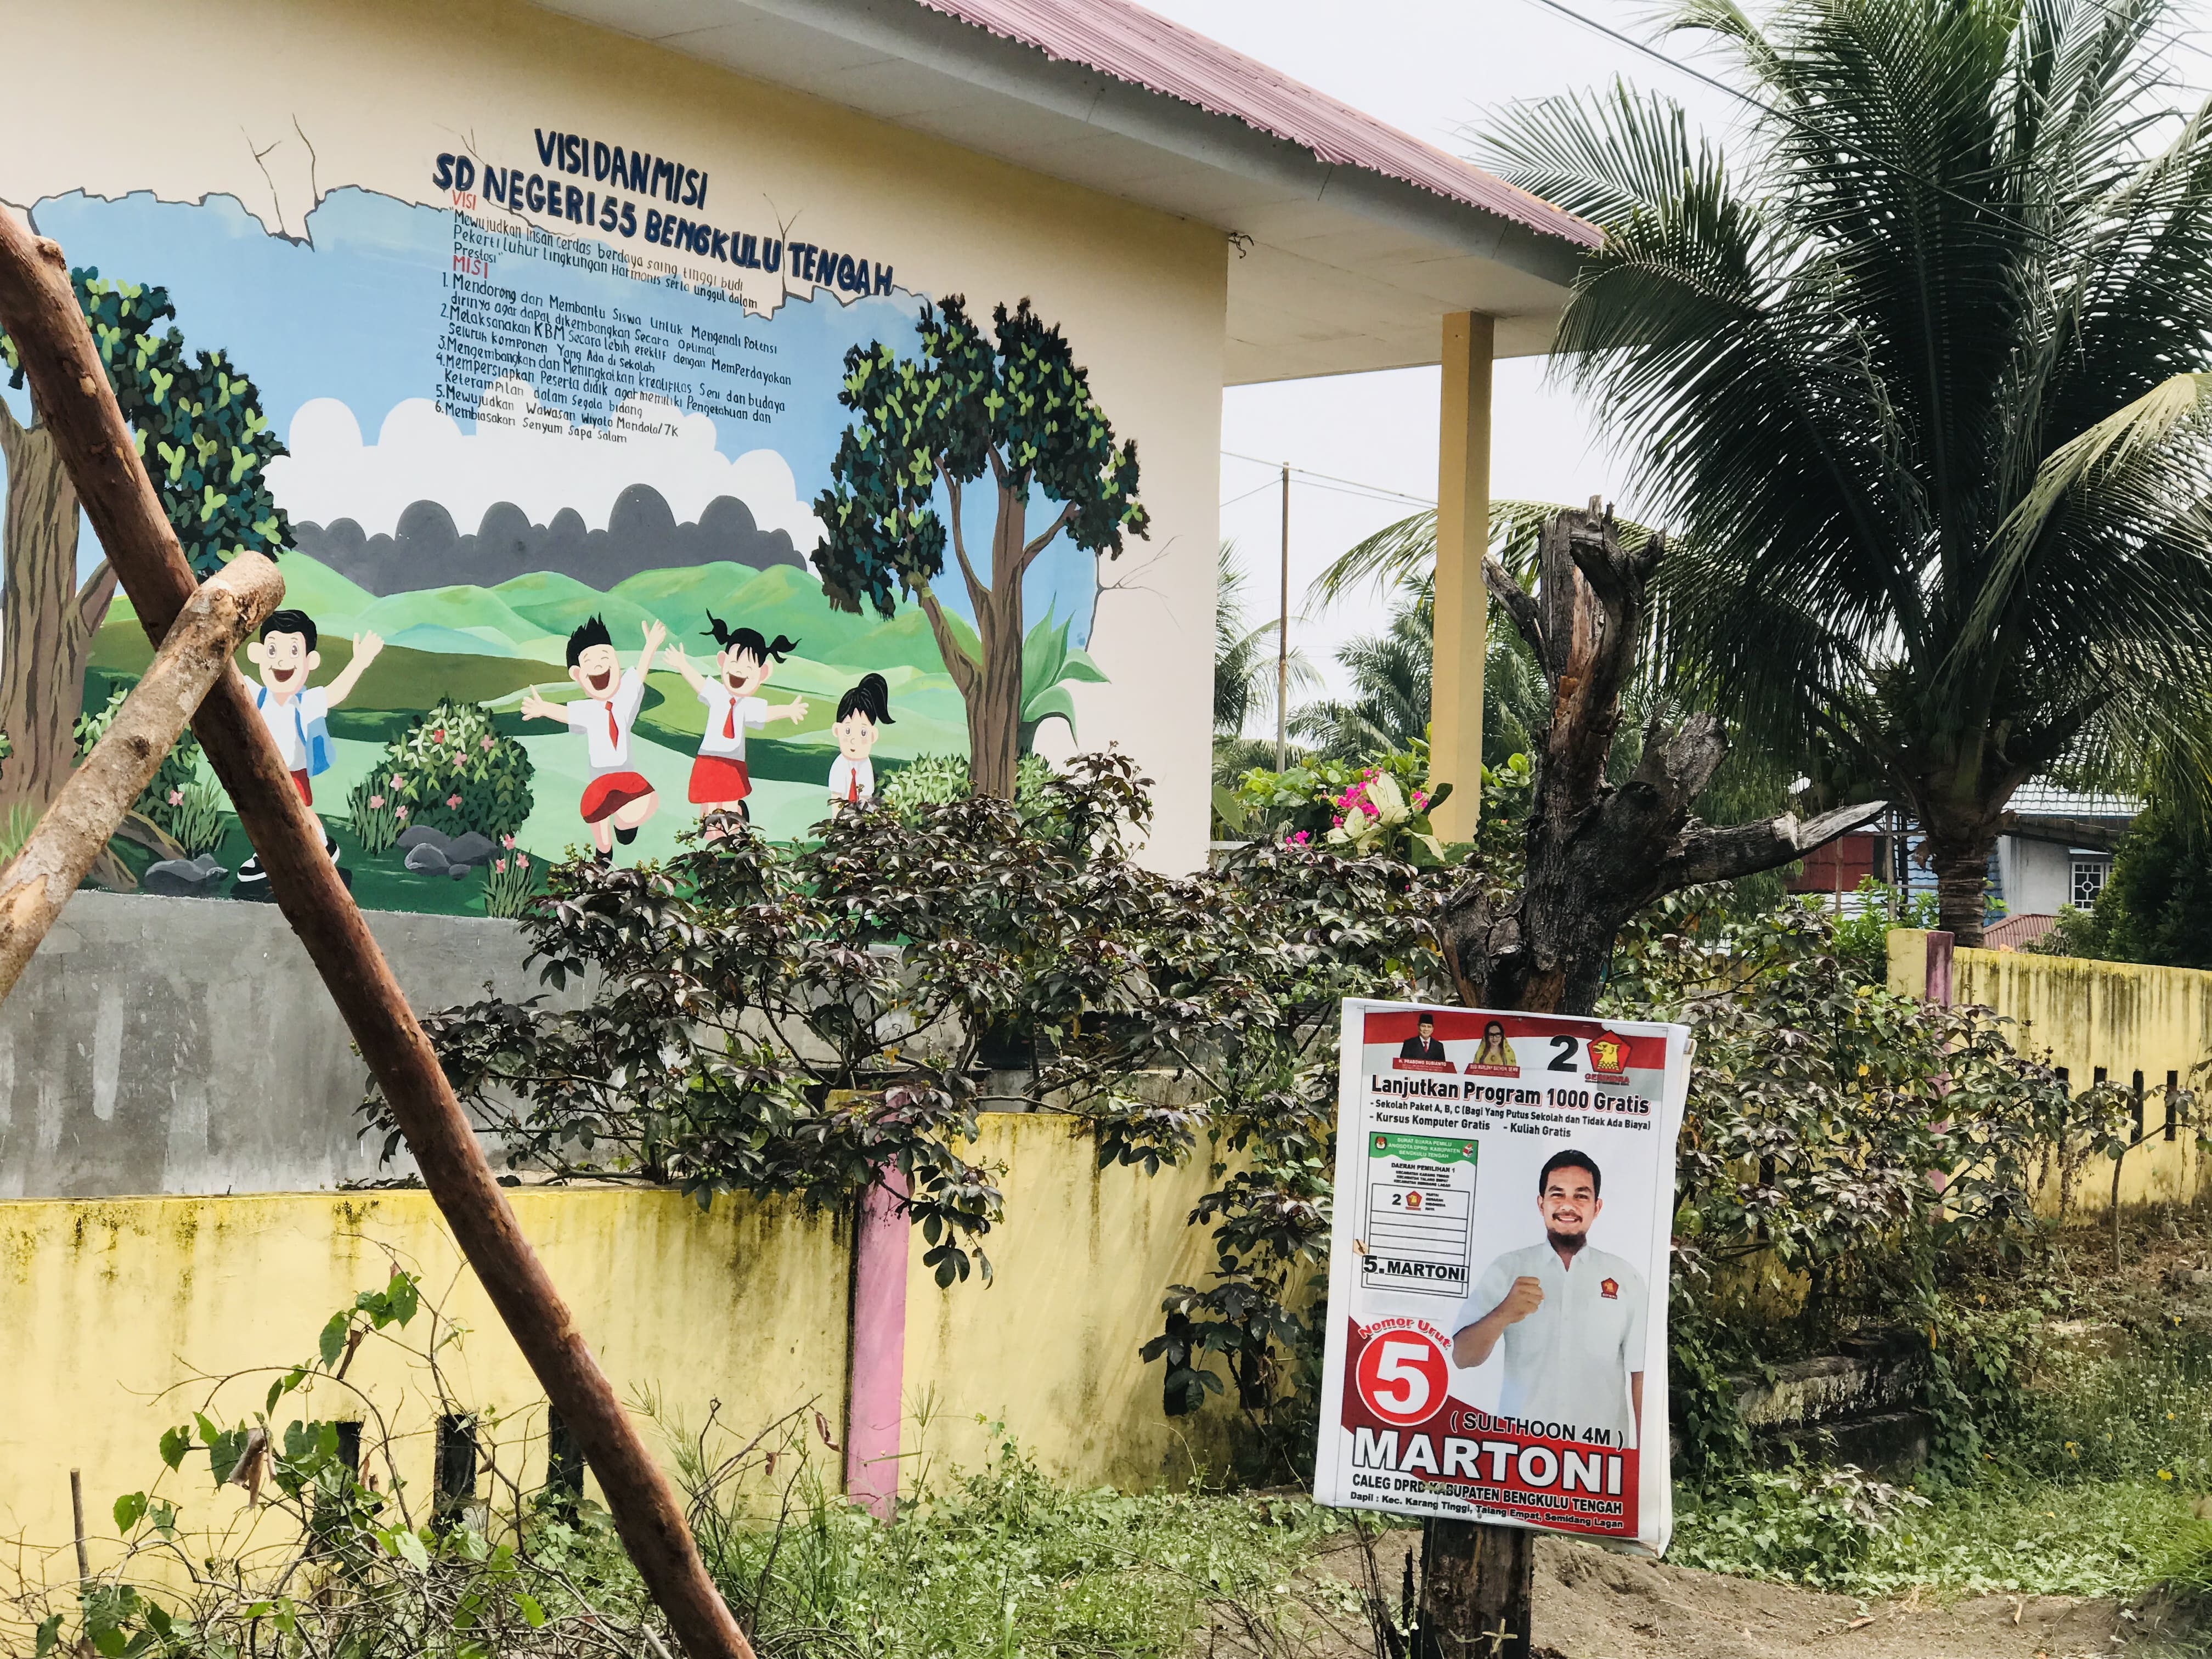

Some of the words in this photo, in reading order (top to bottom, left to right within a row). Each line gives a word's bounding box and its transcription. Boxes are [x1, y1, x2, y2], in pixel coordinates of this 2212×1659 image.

[452, 190, 477, 211] VISI
[433, 153, 475, 193] SD
[483, 164, 595, 225] NEGERI
[599, 196, 637, 238] 55
[644, 208, 782, 273] BENGKULU
[787, 241, 893, 296] TENGAH
[453, 224, 499, 249] Pekerti
[503, 237, 539, 257] luhur
[612, 263, 661, 285] Harmonis
[694, 285, 725, 303] unggul
[453, 255, 488, 279] MISI
[597, 243, 643, 269] berdaya
[683, 267, 716, 286] tinggi
[721, 276, 742, 291] budi
[442, 272, 448, 287] 1.
[453, 273, 516, 304] Mendorong
[521, 291, 543, 307] dan
[550, 295, 605, 319] Membantu
[613, 308, 641, 325] Siswa
[691, 325, 741, 347] Mengenali
[451, 291, 490, 312] dirinya
[494, 303, 517, 317] agar
[556, 314, 630, 338] dikembangkan
[635, 329, 669, 347] Secara
[534, 321, 565, 341] KBM
[605, 337, 630, 354] lebih
[673, 352, 705, 369] dengan
[557, 344, 581, 363] Yang
[586, 349, 603, 363] Ada
[608, 354, 616, 365] di
[534, 386, 567, 404] dalam
[609, 400, 642, 419] bidang
[538, 356, 560, 370] dan
[563, 357, 634, 385] Meningkatkan
[699, 382, 720, 399] Seni
[726, 390, 745, 405] dan
[748, 392, 785, 414] budaya
[540, 370, 579, 391] Peserta
[583, 379, 608, 396] didik
[614, 388, 637, 400] agar
[640, 391, 682, 408] memiliki
[687, 395, 748, 420] Pengetahuan
[753, 409, 771, 424] dan
[445, 402, 516, 426] Membiasakan
[523, 417, 562, 435] Senyum
[568, 425, 592, 440] Sapa
[597, 431, 627, 443] Salam
[526, 402, 575, 421] Wawasan
[1547, 1035, 1579, 1073] 2
[1372, 1074, 1459, 1099] Lanjutkan
[1464, 1081, 1541, 1105] Program
[1547, 1088, 1589, 1109] 1000
[1594, 1092, 1650, 1114] Gratis
[1375, 1099, 1408, 1110] Sekolah
[1410, 1102, 1433, 1113] Paket
[1434, 1104, 1443, 1114] A,
[1444, 1104, 1453, 1115] B,
[1454, 1105, 1460, 1114] C
[1462, 1105, 1483, 1118] (Bagi
[1485, 1108, 1504, 1119] Yang
[1506, 1109, 1529, 1120] Putus
[1531, 1111, 1563, 1122] Sekolah
[1565, 1114, 1580, 1124] dan
[1582, 1116, 1605, 1126] Tidak
[1606, 1118, 1622, 1127] Ada
[1624, 1120, 1650, 1131] Biaya)
[1376, 1112, 1410, 1124] Kursus
[1412, 1115, 1459, 1128] Komputer
[1462, 1119, 1490, 1130] Gratis
[1510, 1123, 1539, 1135] Kuliah
[1542, 1126, 1571, 1137] Gratis
[1392, 1194, 1402, 1206] 2
[1387, 1260, 1465, 1280] MARTONI
[1357, 1318, 1415, 1339] Nomor
[1418, 1319, 1452, 1350] Urut
[1373, 1341, 1430, 1414] 5
[1464, 1412, 1576, 1441] SULTHOON
[1582, 1427, 1611, 1445] 4M
[1352, 1426, 1624, 1497] MARTONI
[1352, 1474, 1391, 1489] CALEG
[1394, 1479, 1425, 1493] DPRD
[1428, 1481, 1499, 1502] KABUPATEN
[1503, 1490, 1568, 1509] BENGKULU
[1572, 1498, 1622, 1515] TENGAH
[1381, 1495, 1403, 1505] Kec.
[1405, 1498, 1438, 1510] Karang
[1441, 1502, 1472, 1514] Tinggi,
[1476, 1504, 1506, 1517] Talang
[1510, 1509, 1542, 1522] Empat,
[1545, 1513, 1591, 1527] Semidang
[1594, 1519, 1623, 1529] Lagan
